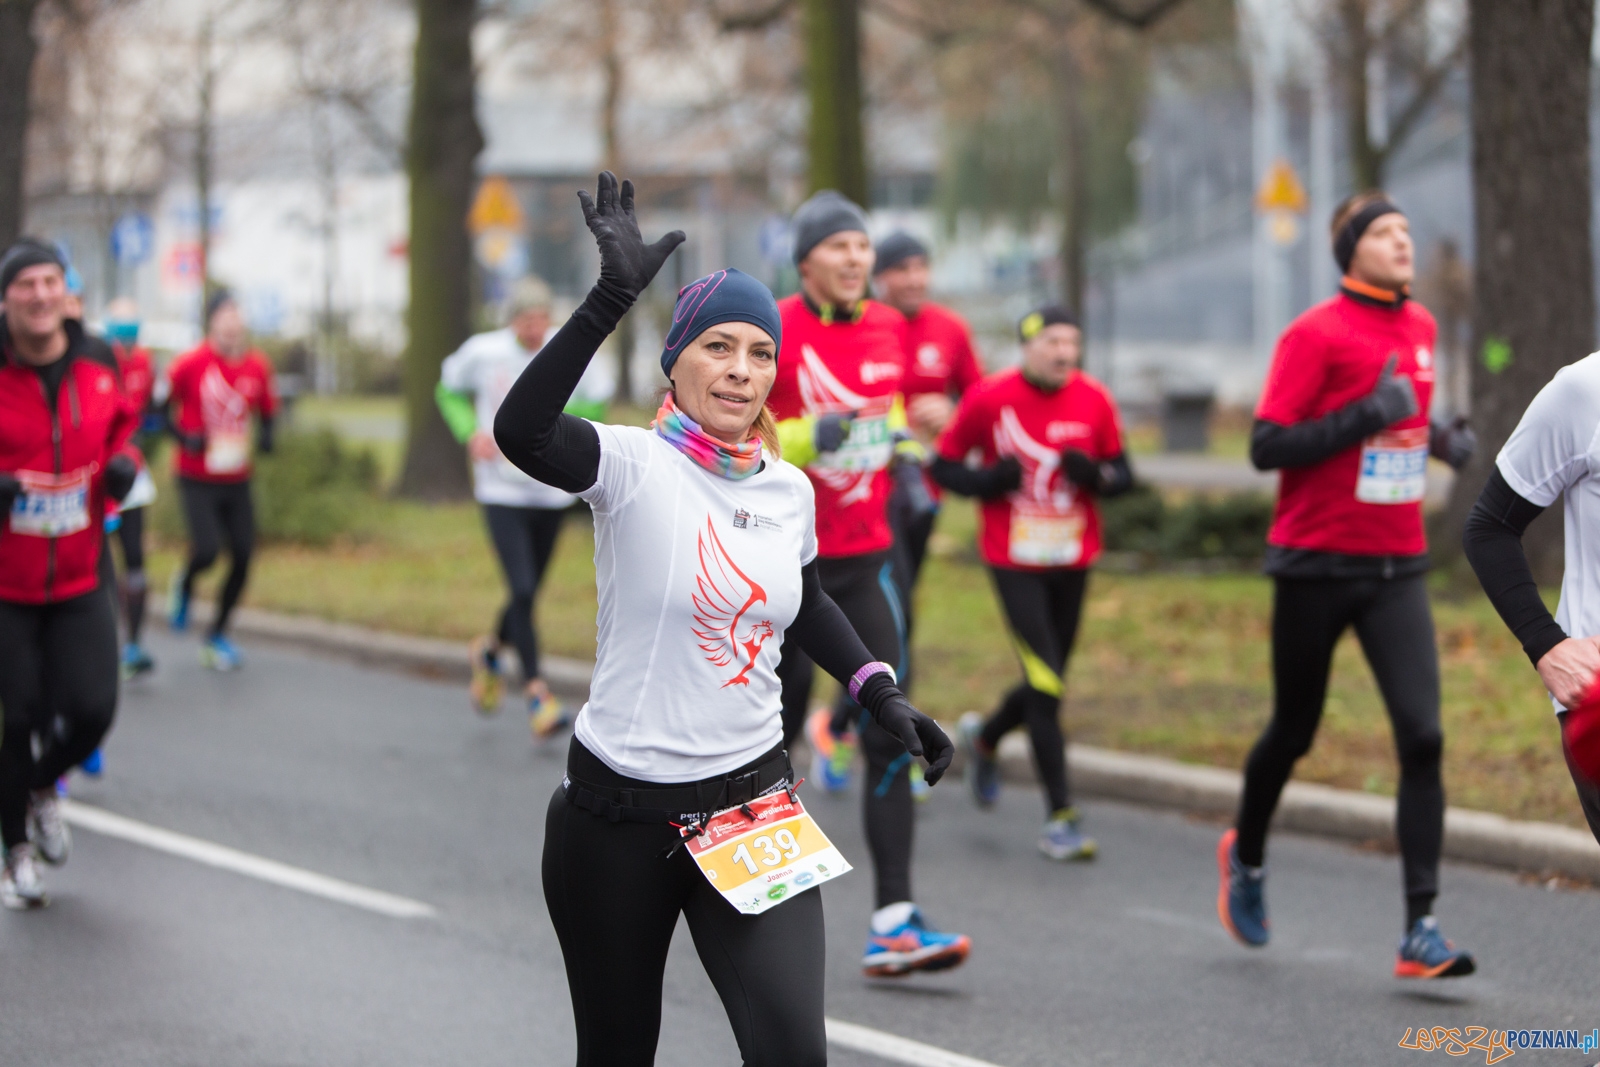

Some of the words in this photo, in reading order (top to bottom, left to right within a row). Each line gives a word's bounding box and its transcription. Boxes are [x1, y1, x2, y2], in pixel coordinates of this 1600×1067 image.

[732, 828, 801, 875] 139
[707, 869, 718, 880] D
[767, 869, 793, 882] Joanna
